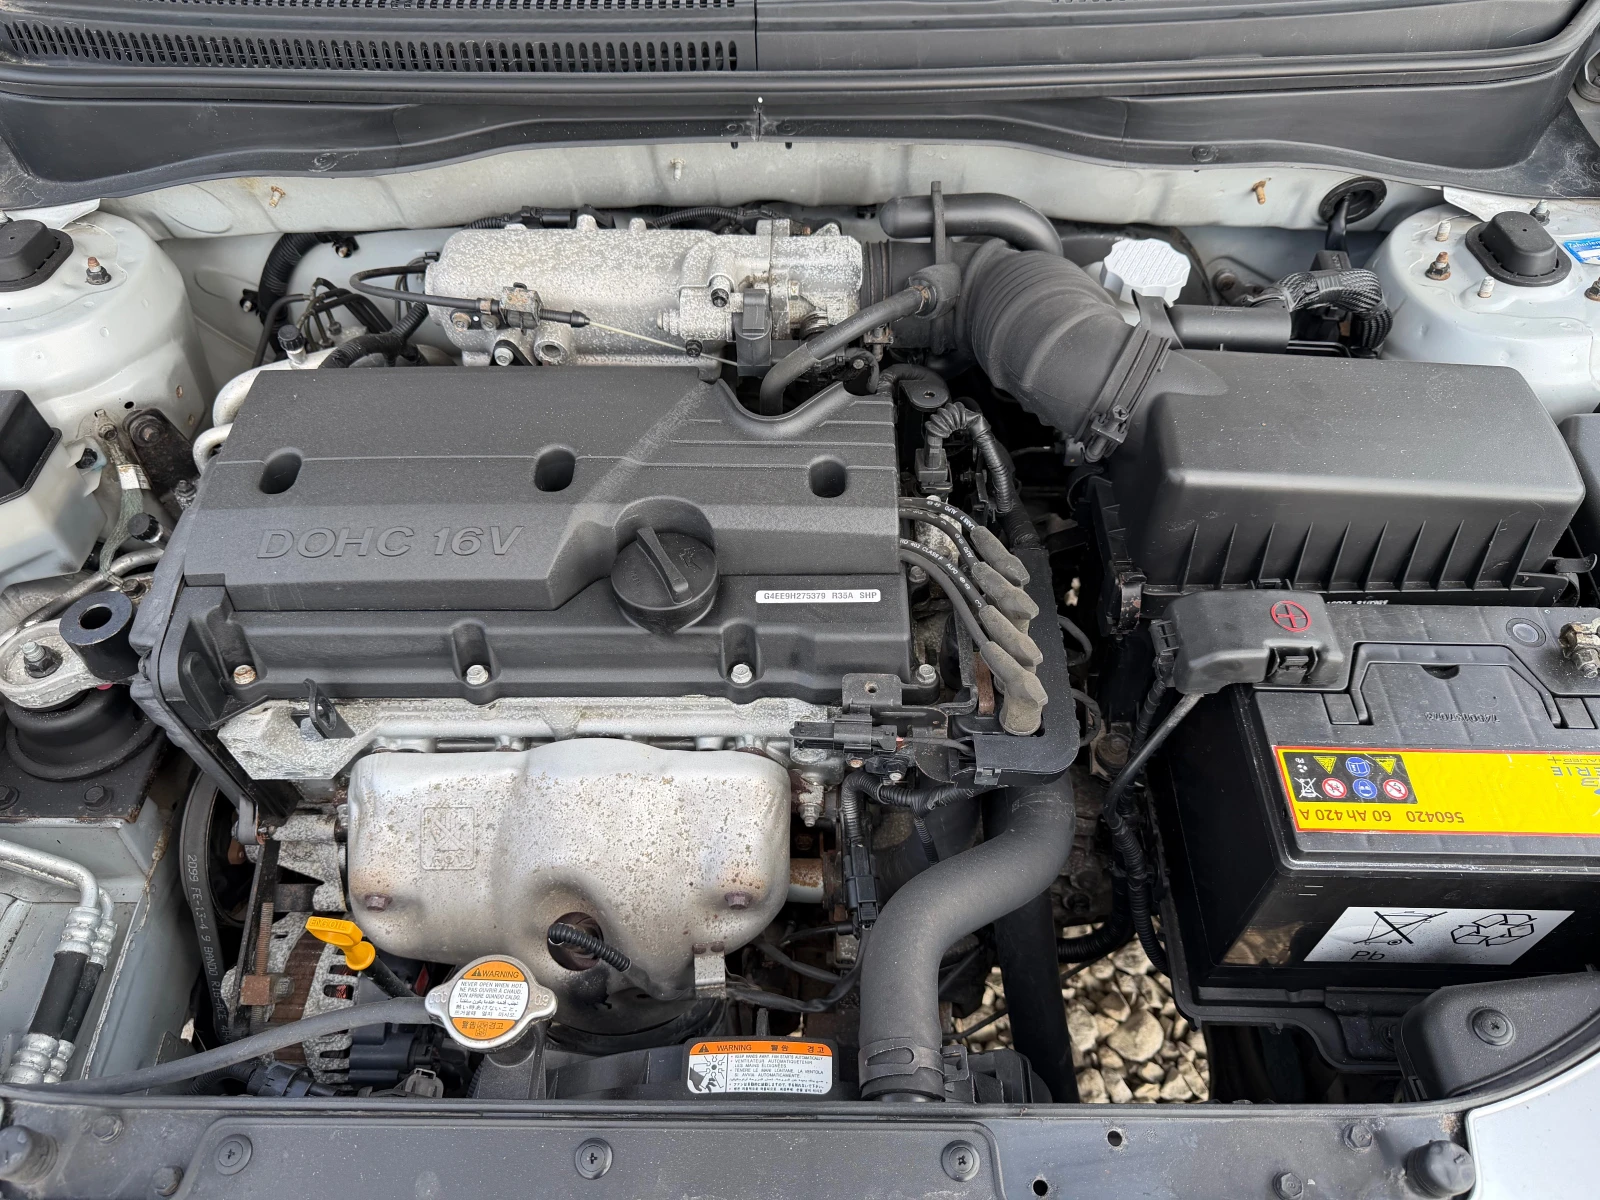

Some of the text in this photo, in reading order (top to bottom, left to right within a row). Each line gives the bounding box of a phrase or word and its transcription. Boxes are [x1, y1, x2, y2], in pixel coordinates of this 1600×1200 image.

[256, 526, 524, 559] DOHC 16V
[763, 591, 877, 600] G4EE9H275379 R35A SHP
[1298, 808, 1465, 823] 560420 60 Ah 420 A
[309, 918, 347, 930] ENG OIL
[187, 854, 199, 883] 2099
[203, 946, 218, 976] BANDO
[211, 980, 228, 1020] RIB-ACE
[1350, 950, 1386, 961] Pb
[482, 970, 519, 979] WARNING
[488, 1022, 504, 1030] 경고
